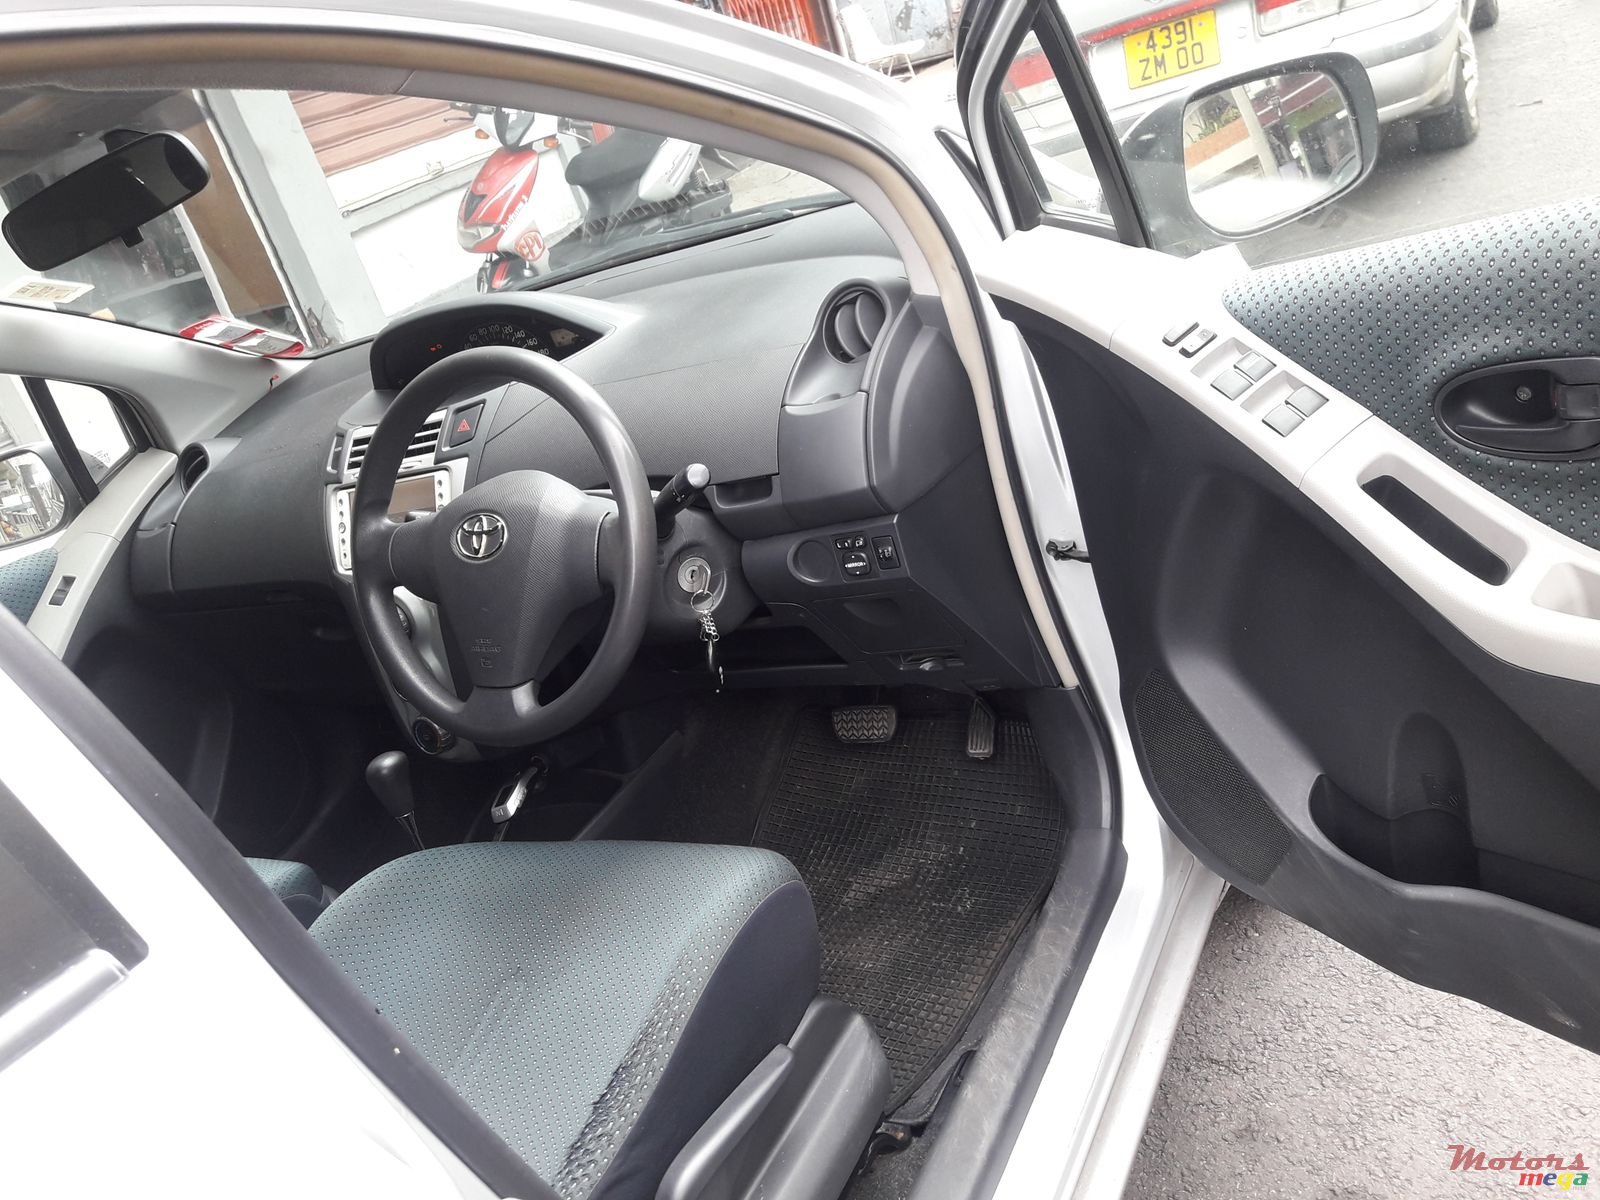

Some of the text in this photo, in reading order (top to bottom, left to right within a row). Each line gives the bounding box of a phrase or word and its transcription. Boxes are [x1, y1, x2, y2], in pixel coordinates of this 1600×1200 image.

[1146, 18, 1194, 52] 4391
[1139, 53, 1167, 81] ZM
[502, 325, 513, 334] 120
[514, 330, 526, 338] 140
[526, 338, 538, 346] 160
